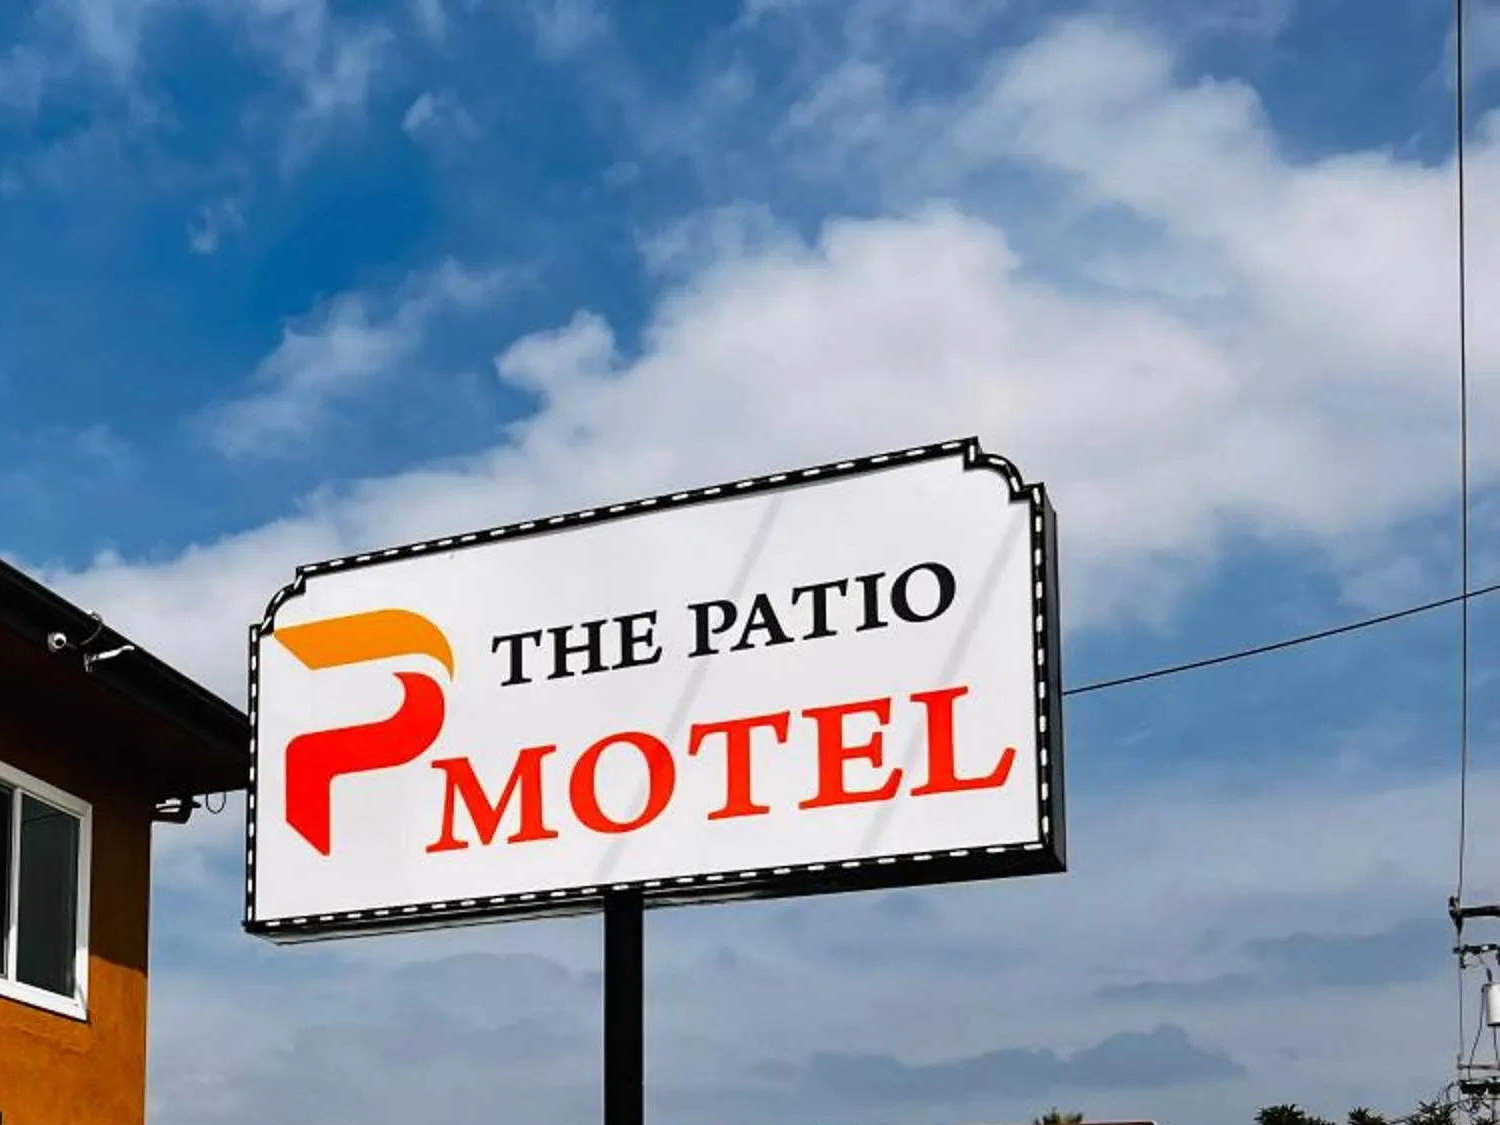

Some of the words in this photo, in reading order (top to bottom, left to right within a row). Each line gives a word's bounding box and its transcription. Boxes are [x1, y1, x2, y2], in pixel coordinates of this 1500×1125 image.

[491, 610, 663, 687] THE
[687, 561, 957, 658] PATIO
[425, 685, 1017, 853] MOTEL
